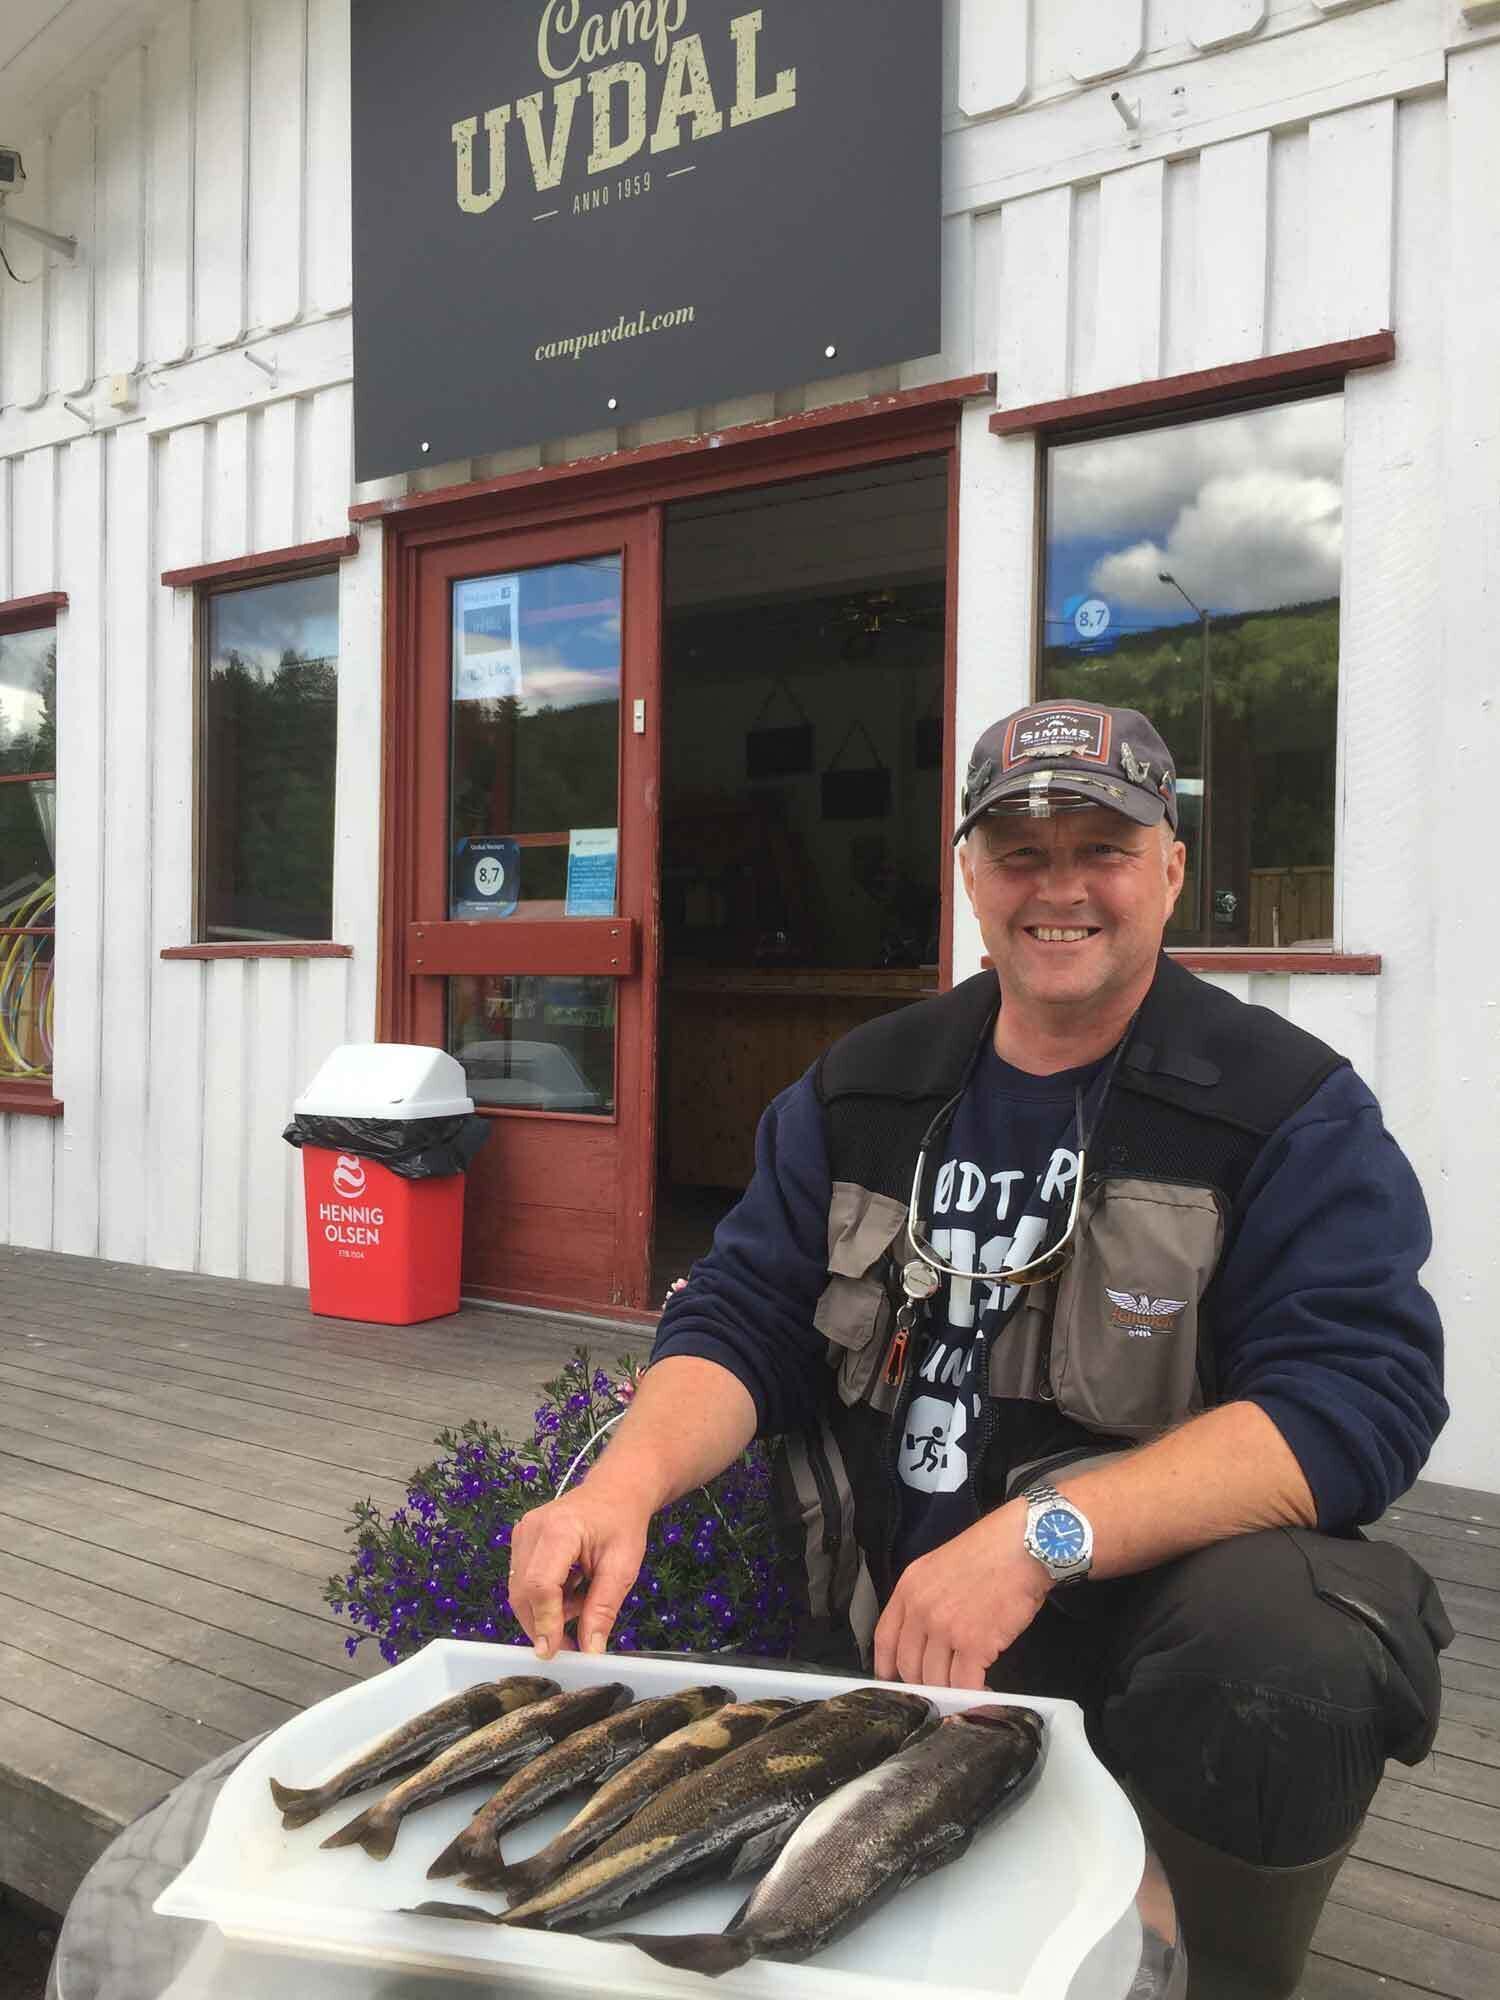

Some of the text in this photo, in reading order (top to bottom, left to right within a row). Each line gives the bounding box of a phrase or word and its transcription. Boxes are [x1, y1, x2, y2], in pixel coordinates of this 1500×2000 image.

[537, 0, 688, 79] Camp
[451, 9, 797, 214] UVDAL
[572, 172, 651, 215] ANNO 1959
[534, 305, 695, 361] campuvdal.com
[1020, 727, 1091, 743] SIMMS
[479, 867, 500, 885] 8,7
[319, 1203, 384, 1225] HENNIG
[325, 1224, 380, 1245] OLSEN
